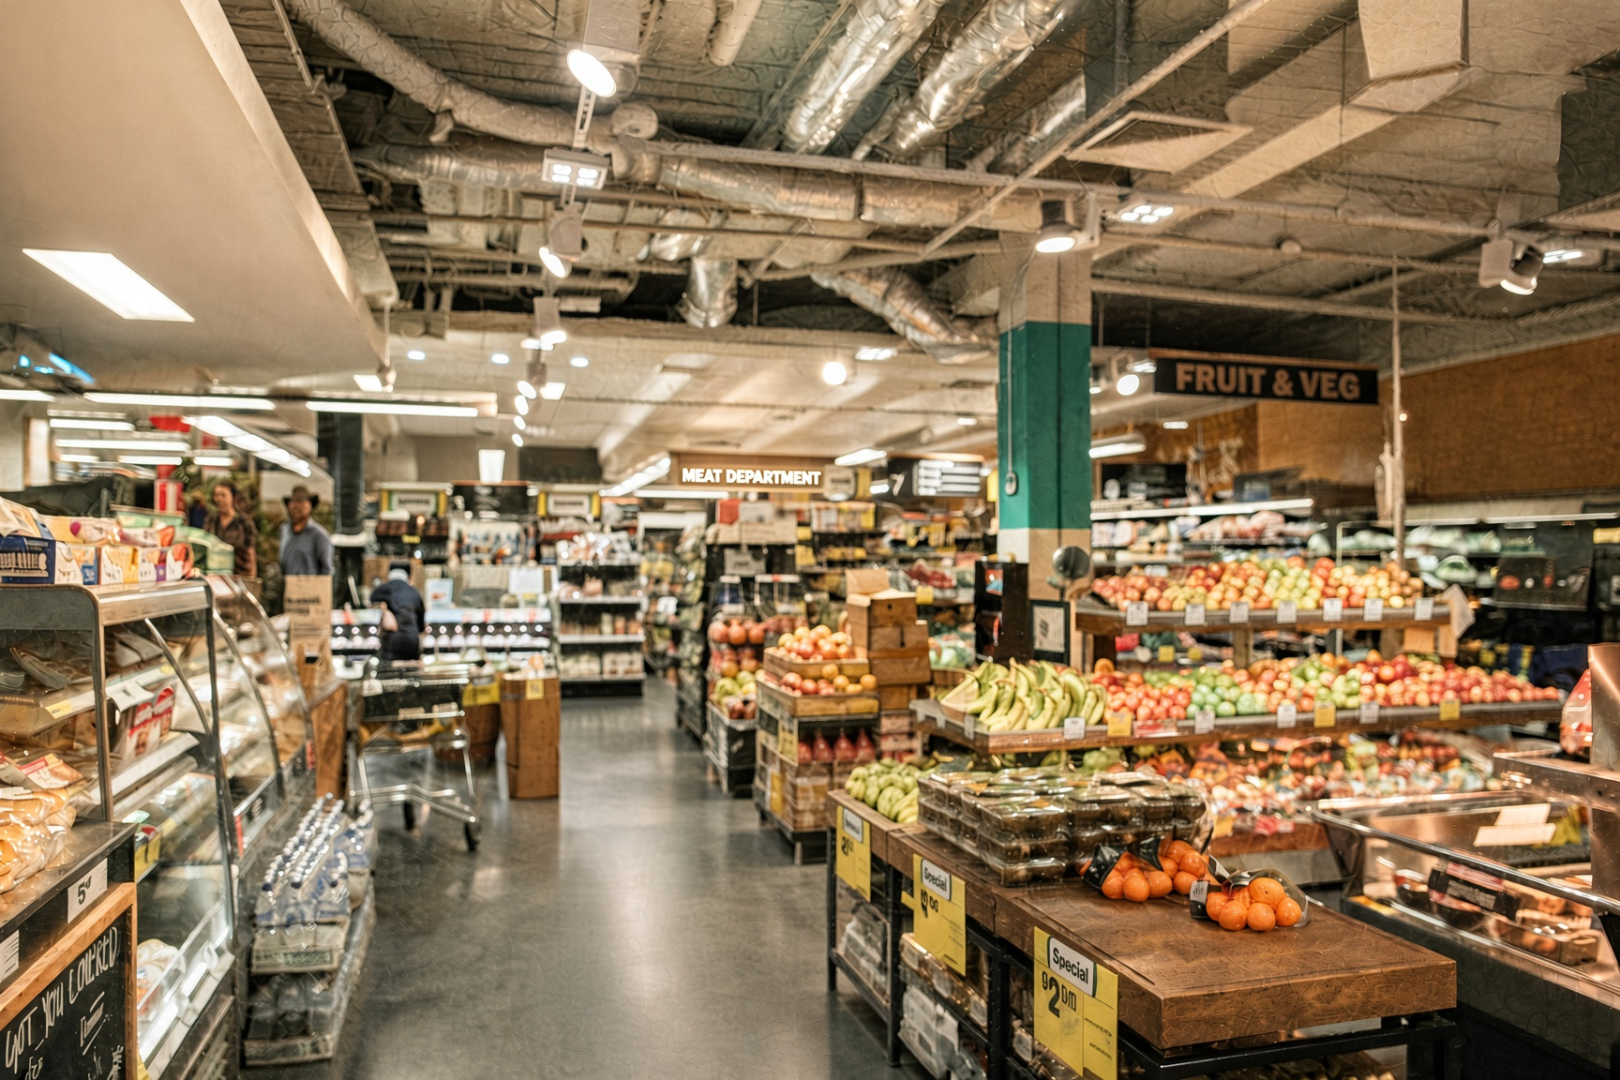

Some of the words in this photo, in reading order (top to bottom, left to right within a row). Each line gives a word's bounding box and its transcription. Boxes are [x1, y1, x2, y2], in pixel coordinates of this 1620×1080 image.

[1176, 362, 1267, 395] FRUIT
[1272, 368, 1294, 397] &
[1299, 370, 1361, 400] VEG
[682, 468, 723, 484] MEAT
[726, 469, 821, 485] DEPARTMENT
[924, 867, 947, 892] Special
[1052, 947, 1089, 984] Special
